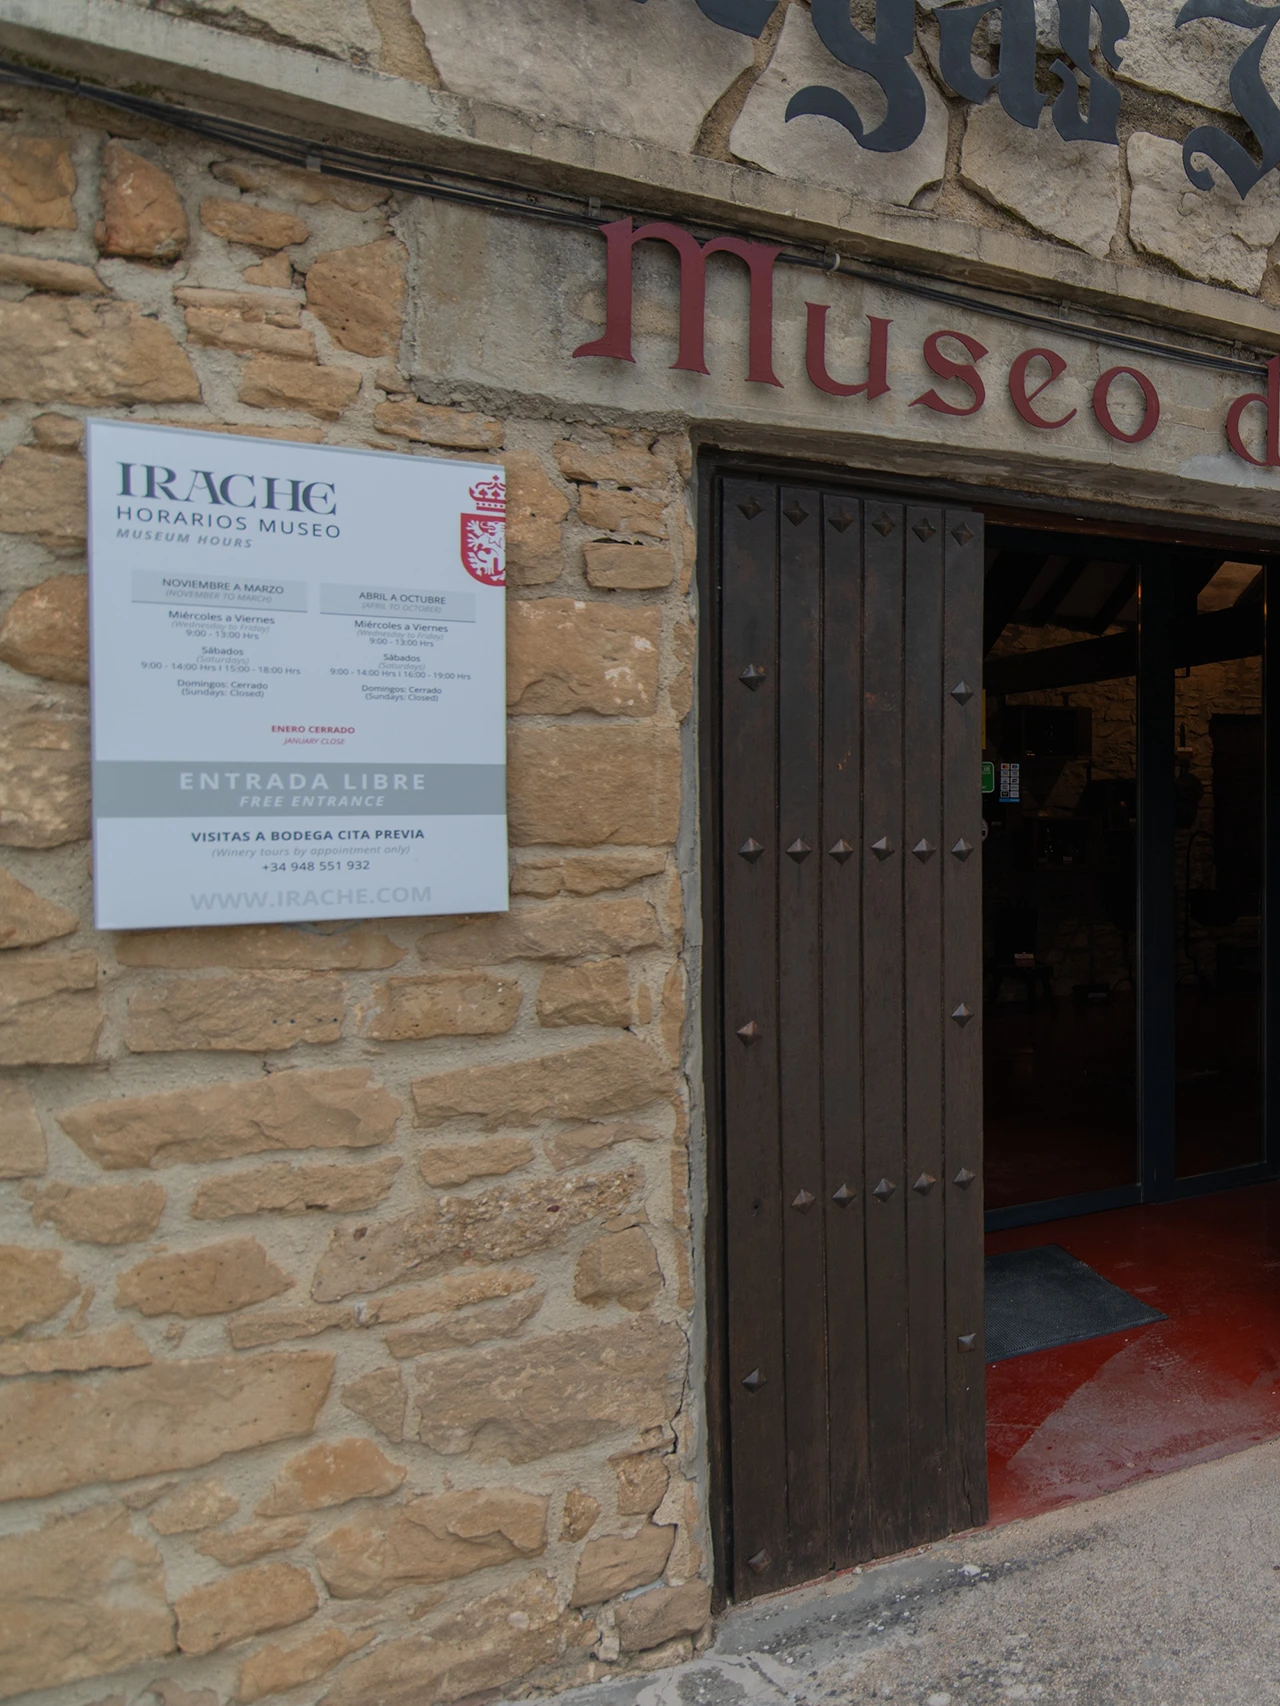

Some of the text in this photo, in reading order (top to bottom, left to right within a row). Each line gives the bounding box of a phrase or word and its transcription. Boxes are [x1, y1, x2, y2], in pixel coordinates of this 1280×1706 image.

[572, 215, 1160, 443] Museo
[116, 461, 338, 516] IRACHE
[117, 506, 340, 538] HORARIOS MUSEO
[116, 528, 253, 548] MUSEUM HOURS
[162, 578, 230, 591] NOVIEMBRE
[245, 584, 284, 594] MARZO
[165, 589, 272, 603] (NOVEMBER TO MARCH)
[359, 592, 388, 601] ABRIL
[400, 595, 446, 604] OCTUBRE
[169, 610, 222, 621] Miércoles
[235, 615, 275, 624] Viernes
[240, 624, 270, 633] Friday)
[355, 620, 401, 630] Miércoles
[413, 624, 448, 632] Viernes
[216, 631, 240, 639] 13:00
[243, 632, 259, 640] Hrs
[417, 632, 443, 641] Friday)
[202, 646, 244, 656] Sábados
[383, 653, 420, 662] Sábados
[141, 661, 162, 669] 9:00
[172, 662, 197, 670] 14:00
[200, 664, 216, 672] Hrs
[226, 665, 250, 673] 15:00
[259, 666, 283, 674] 18:00
[177, 679, 268, 689] Domingos: Cerrado
[362, 685, 406, 693] Domingos:
[182, 688, 264, 698] (Sundays: Closed)
[365, 692, 438, 702] (Sundays: Closed)
[272, 725, 355, 734] ENERO CERRADO
[180, 772, 425, 790] ENTRADA LIBRE
[240, 796, 385, 807] FREE ENTRANCE
[191, 829, 424, 842] VISITAS A BODEGA CITA PREVIA
[212, 845, 411, 859] (Winery tours by appointment only)
[262, 860, 370, 872] +34 948 551 932
[190, 886, 432, 910] WWW.IRACHE.COM
